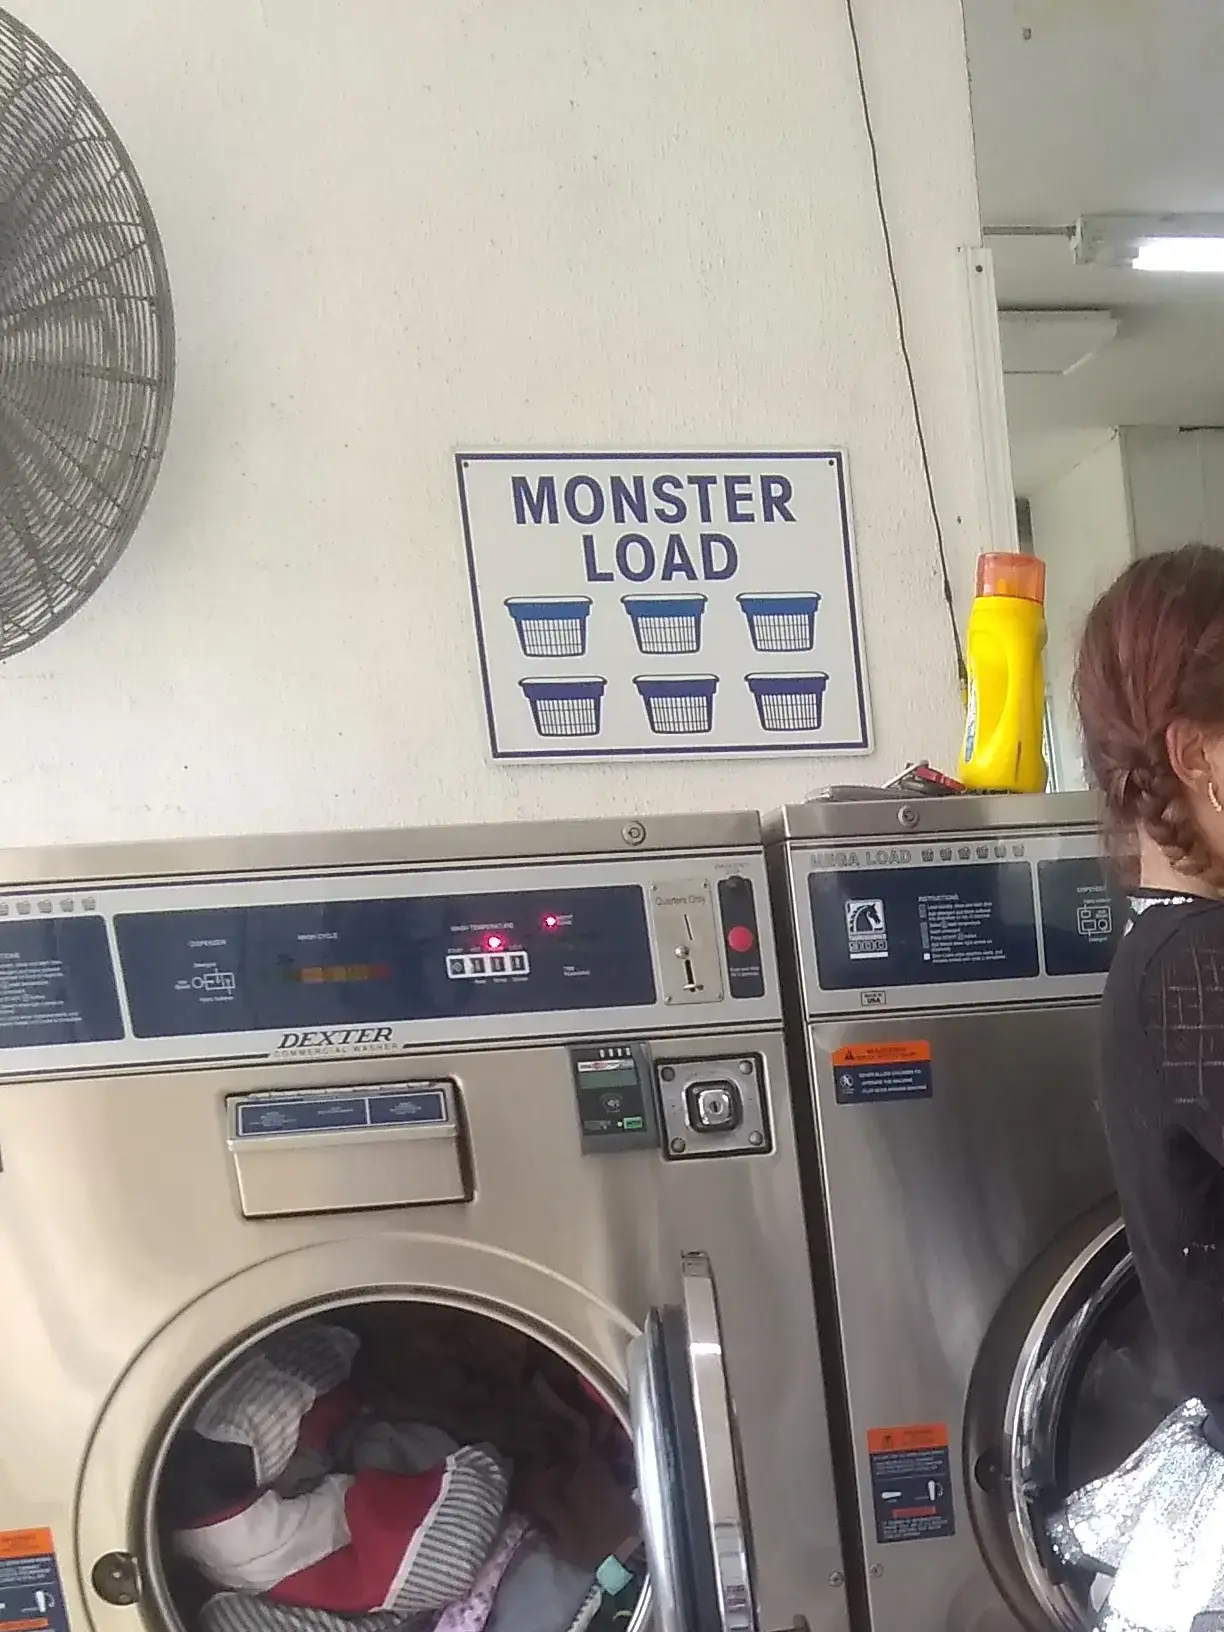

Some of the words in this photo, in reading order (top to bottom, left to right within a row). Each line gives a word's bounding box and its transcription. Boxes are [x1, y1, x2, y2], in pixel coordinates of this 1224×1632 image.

[511, 475, 798, 525] MONSTER
[582, 532, 739, 582] LOAD
[865, 848, 912, 865] LOAD
[277, 1026, 393, 1049] DEXTER
[274, 1047, 347, 1058] COMMERCIAL
[353, 1042, 398, 1053] WASHER
